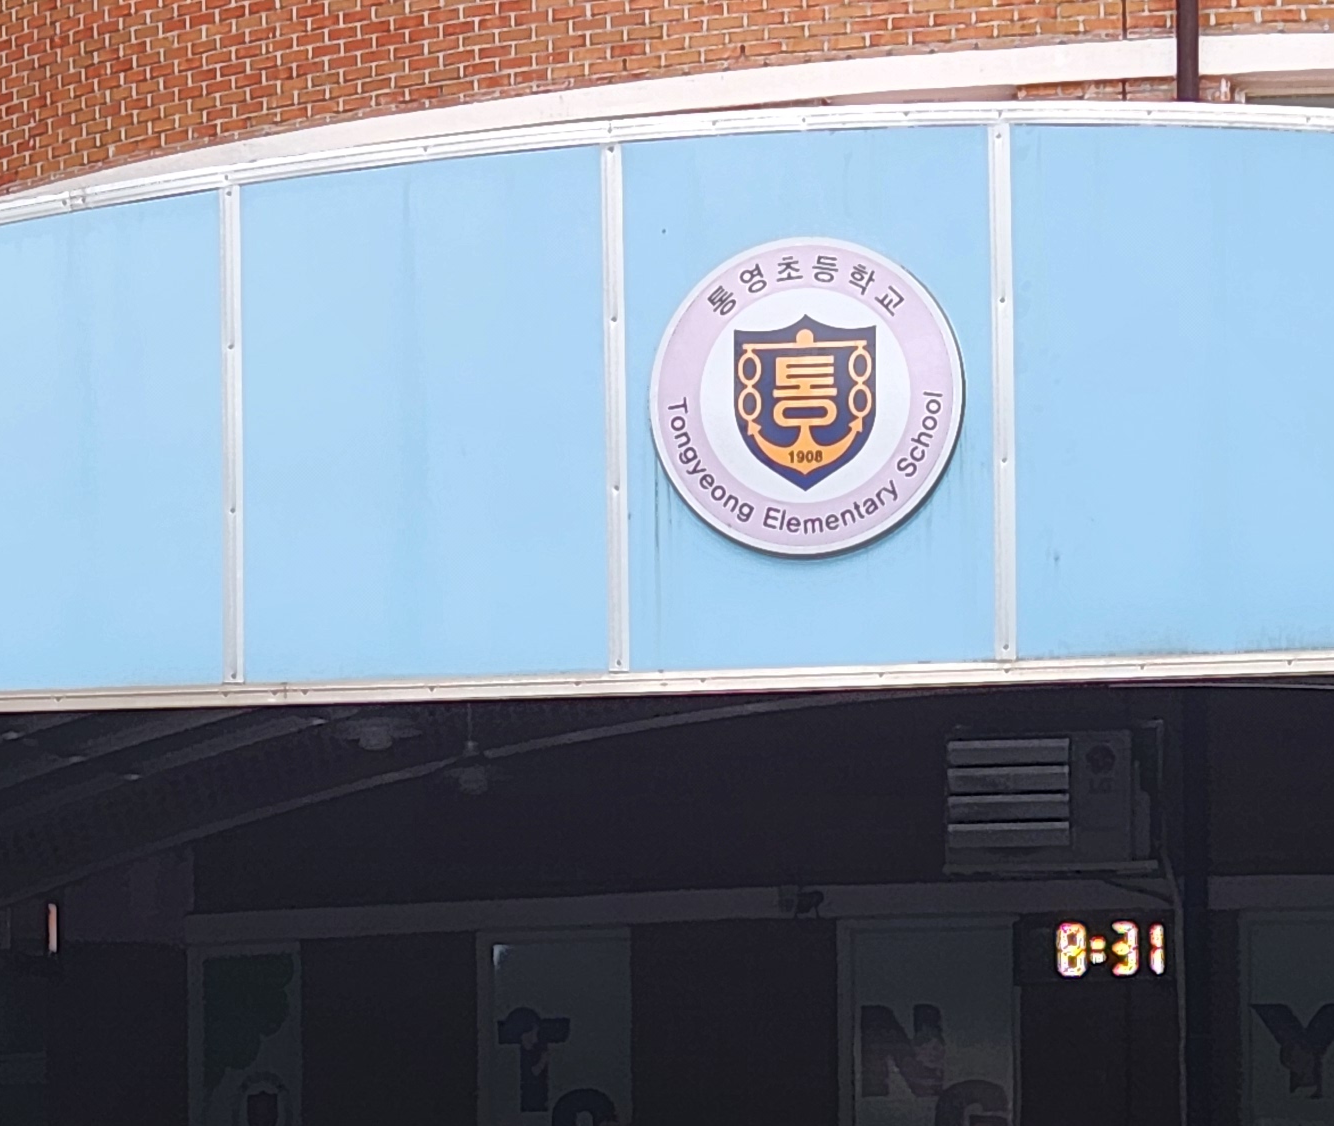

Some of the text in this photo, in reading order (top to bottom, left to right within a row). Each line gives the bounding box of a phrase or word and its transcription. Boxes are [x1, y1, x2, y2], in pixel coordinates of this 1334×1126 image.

[707, 255, 905, 316] 통영초등학교
[667, 391, 944, 535] Tongyeong Elementary School
[788, 450, 823, 464] 1908
[1056, 920, 1165, 978] 8:31
